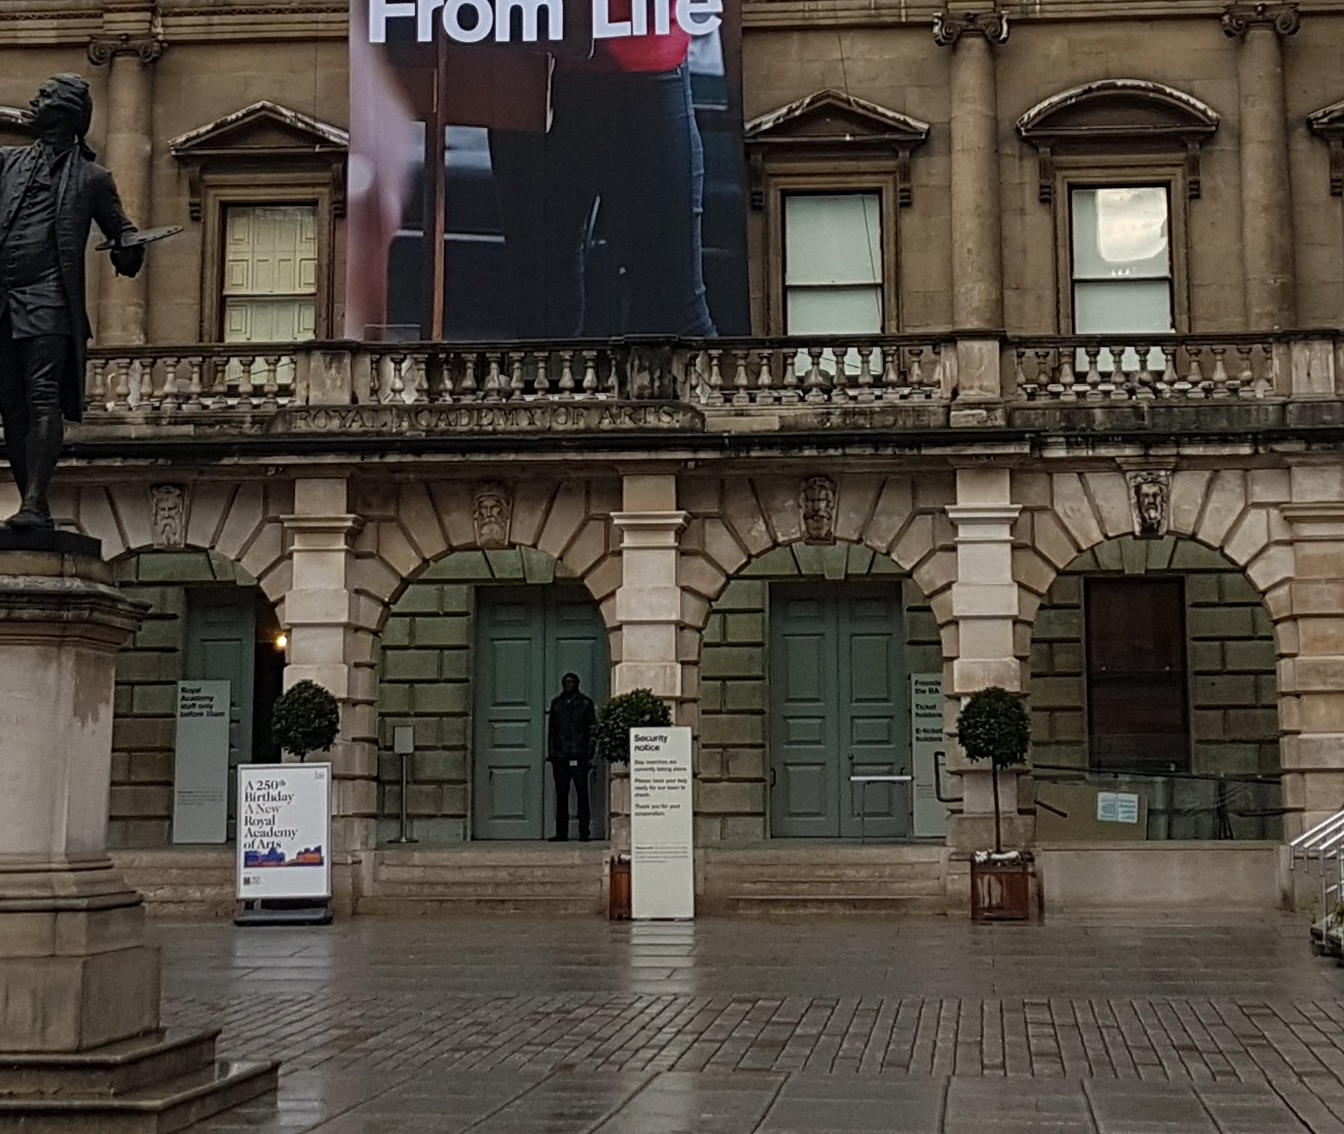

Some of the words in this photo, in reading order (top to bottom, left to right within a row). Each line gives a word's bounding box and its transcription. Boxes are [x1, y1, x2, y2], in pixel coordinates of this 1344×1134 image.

[292, 409, 388, 429] ROYAL
[396, 407, 543, 429] ACADEMY
[553, 406, 588, 426] OF
[633, 734, 669, 744] Security
[634, 744, 661, 752] notice
[244, 780, 255, 791] A
[256, 779, 287, 791] 250th
[244, 792, 295, 804] Birthday
[244, 804, 254, 814] A
[255, 803, 282, 815] New
[244, 815, 276, 829] Royal
[244, 827, 299, 840] Academy
[243, 838, 256, 849] of
[257, 839, 283, 850] Arts
